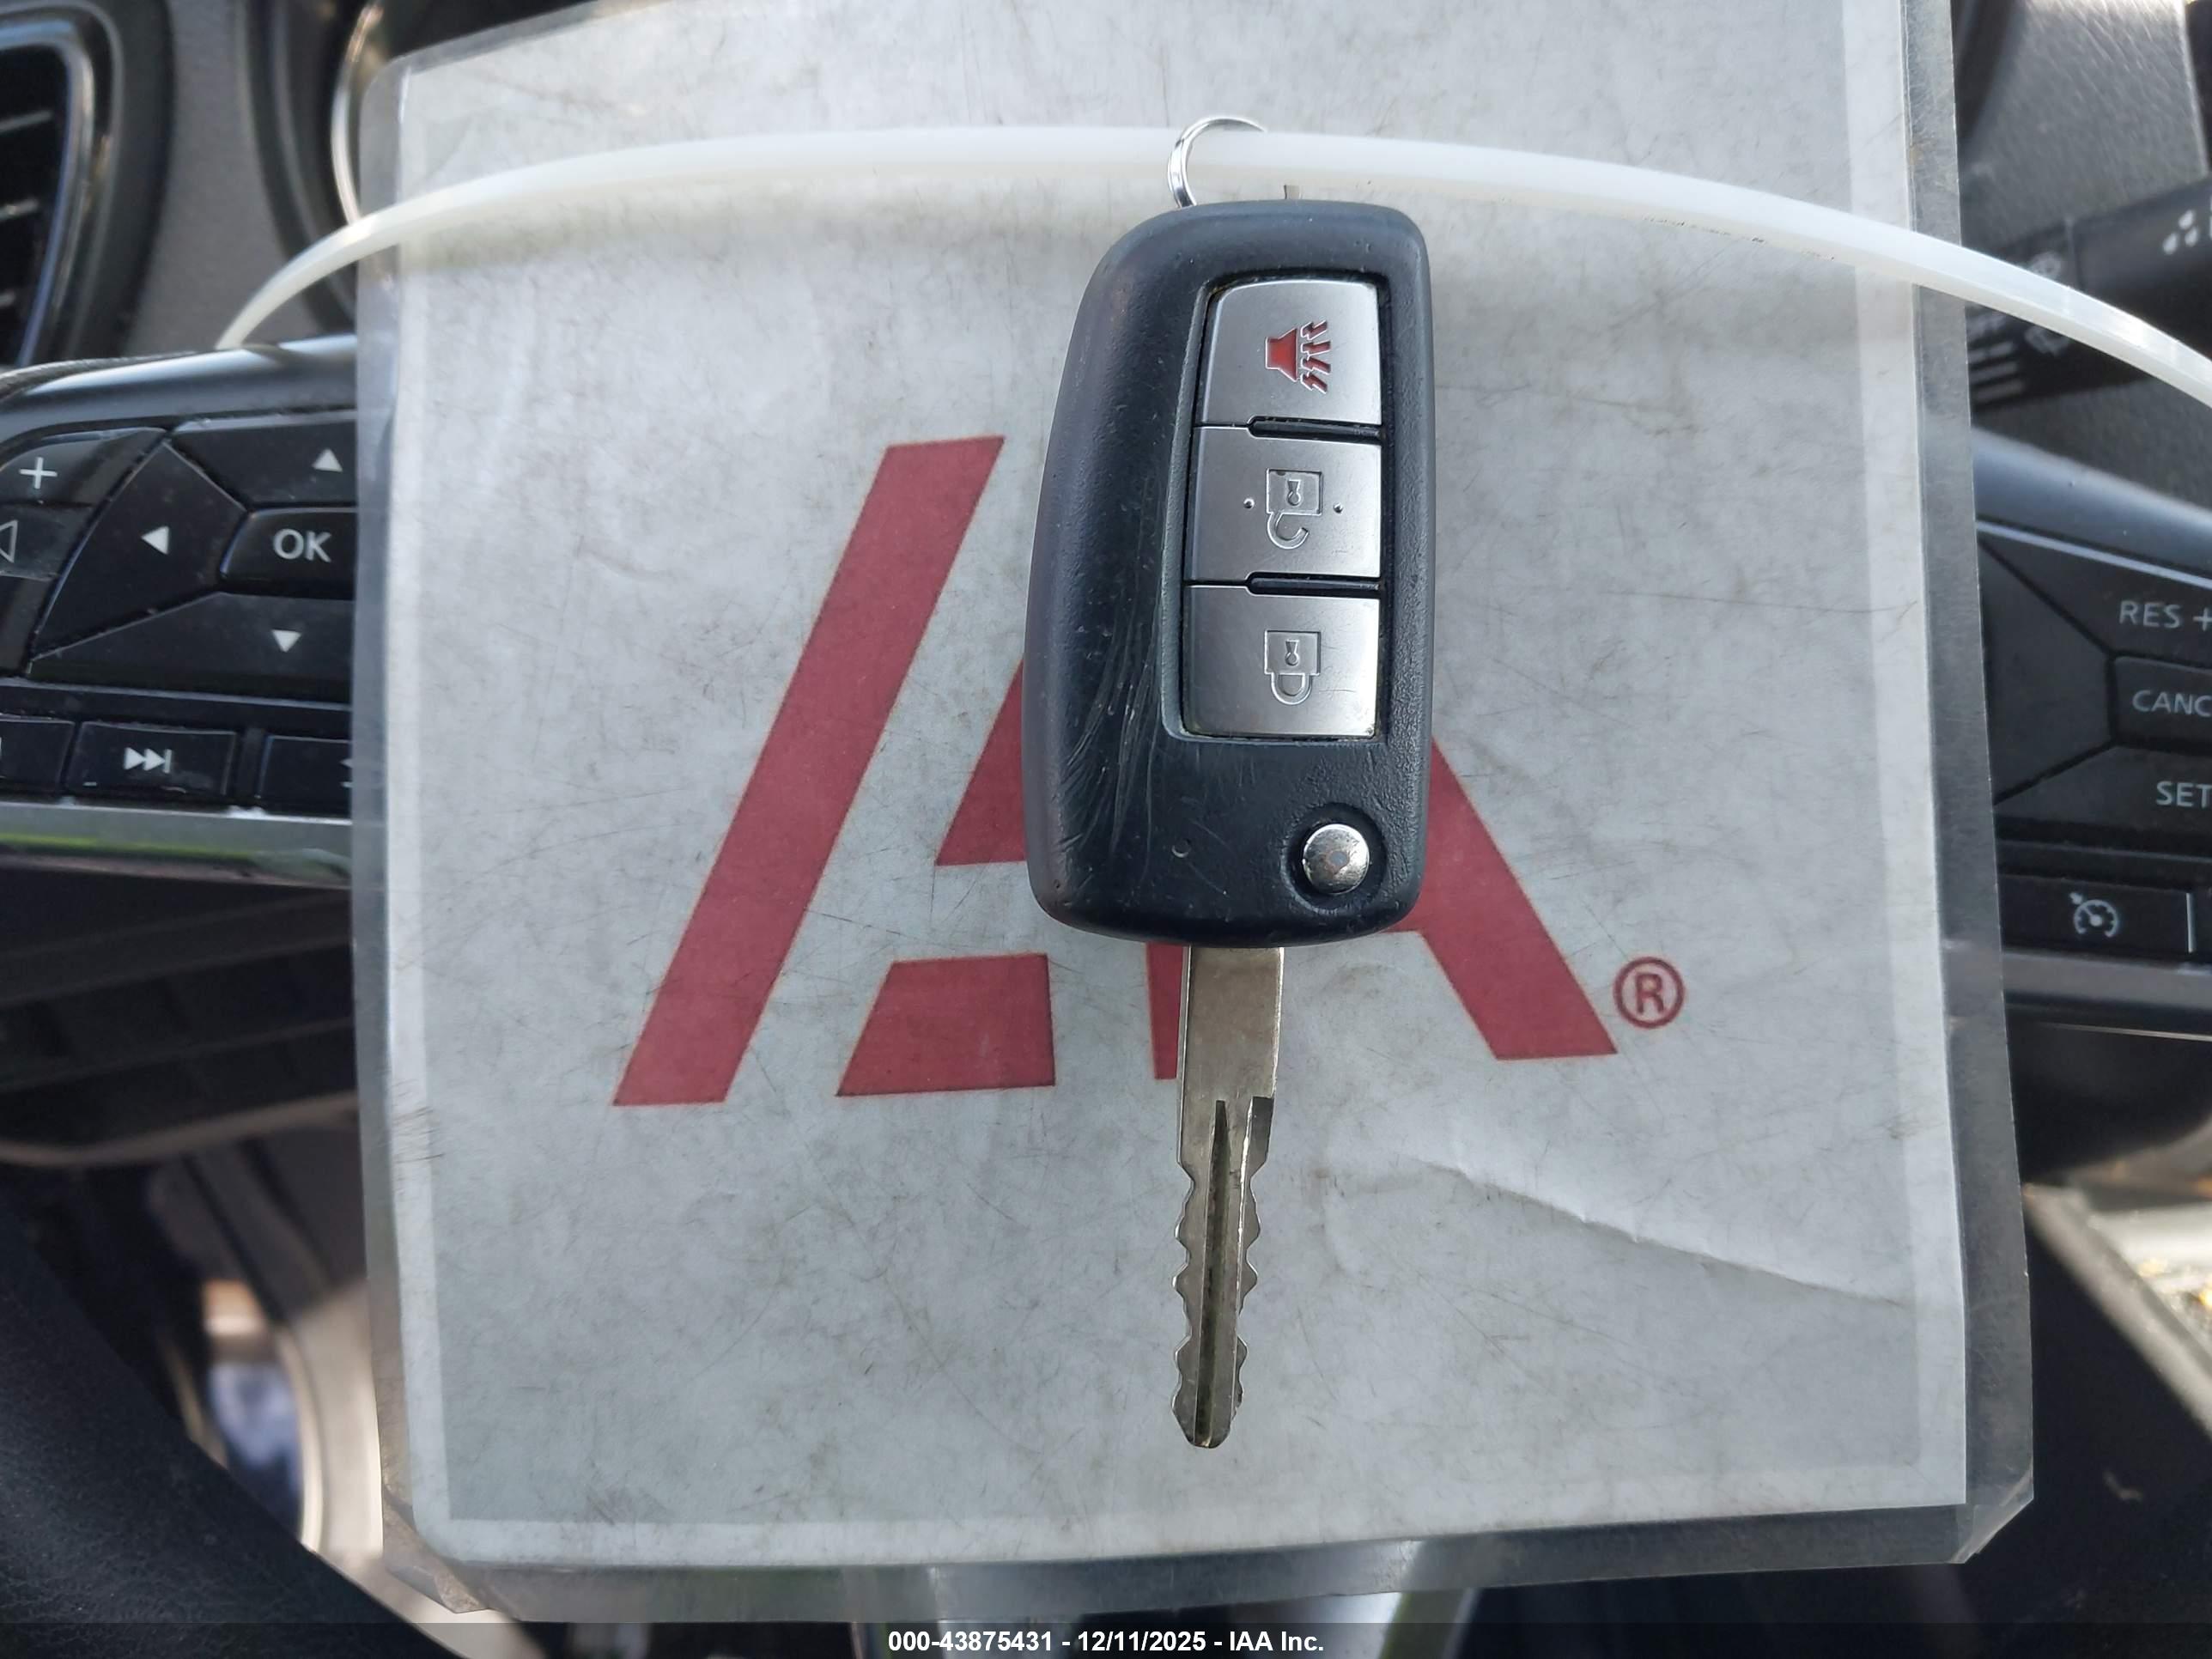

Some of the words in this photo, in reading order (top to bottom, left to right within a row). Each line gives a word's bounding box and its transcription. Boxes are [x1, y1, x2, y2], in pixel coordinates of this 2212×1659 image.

[272, 528, 332, 563] OK
[2118, 599, 2182, 629] RES
[2156, 781, 2212, 808] SET
